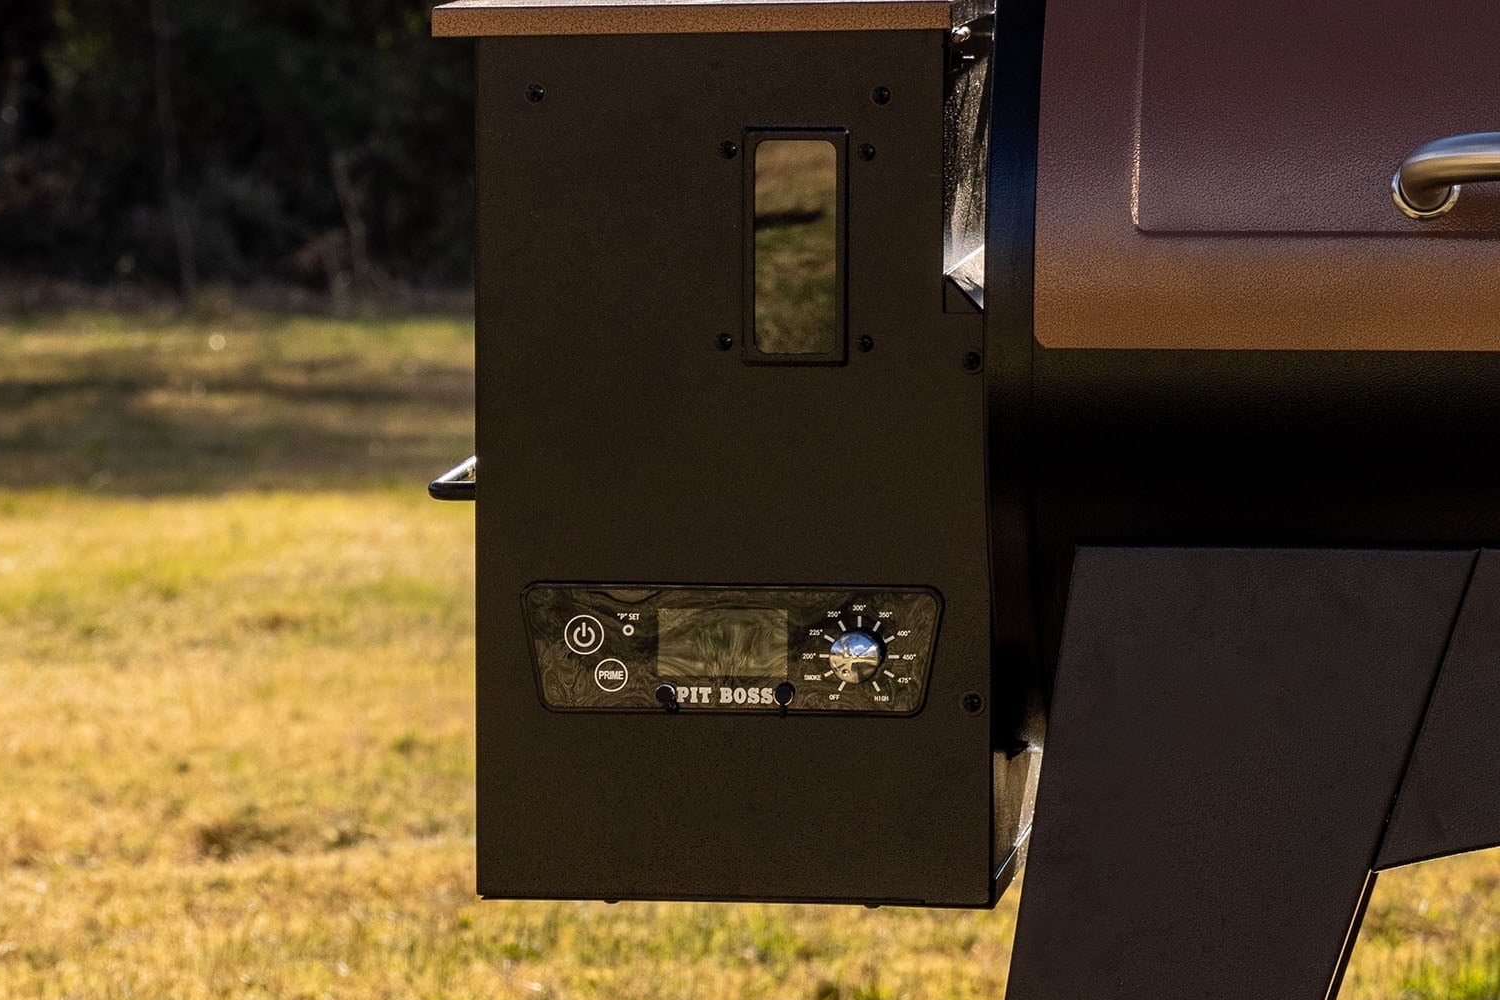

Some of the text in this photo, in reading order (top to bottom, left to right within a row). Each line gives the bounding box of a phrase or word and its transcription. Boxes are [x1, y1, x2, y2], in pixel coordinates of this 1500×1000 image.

[852, 604, 867, 612] 300°
[628, 612, 640, 620] SET
[802, 652, 817, 660] 200°
[902, 653, 917, 661] 450°
[598, 670, 625, 681] PRIME
[676, 686, 774, 705] PIT BOSS
